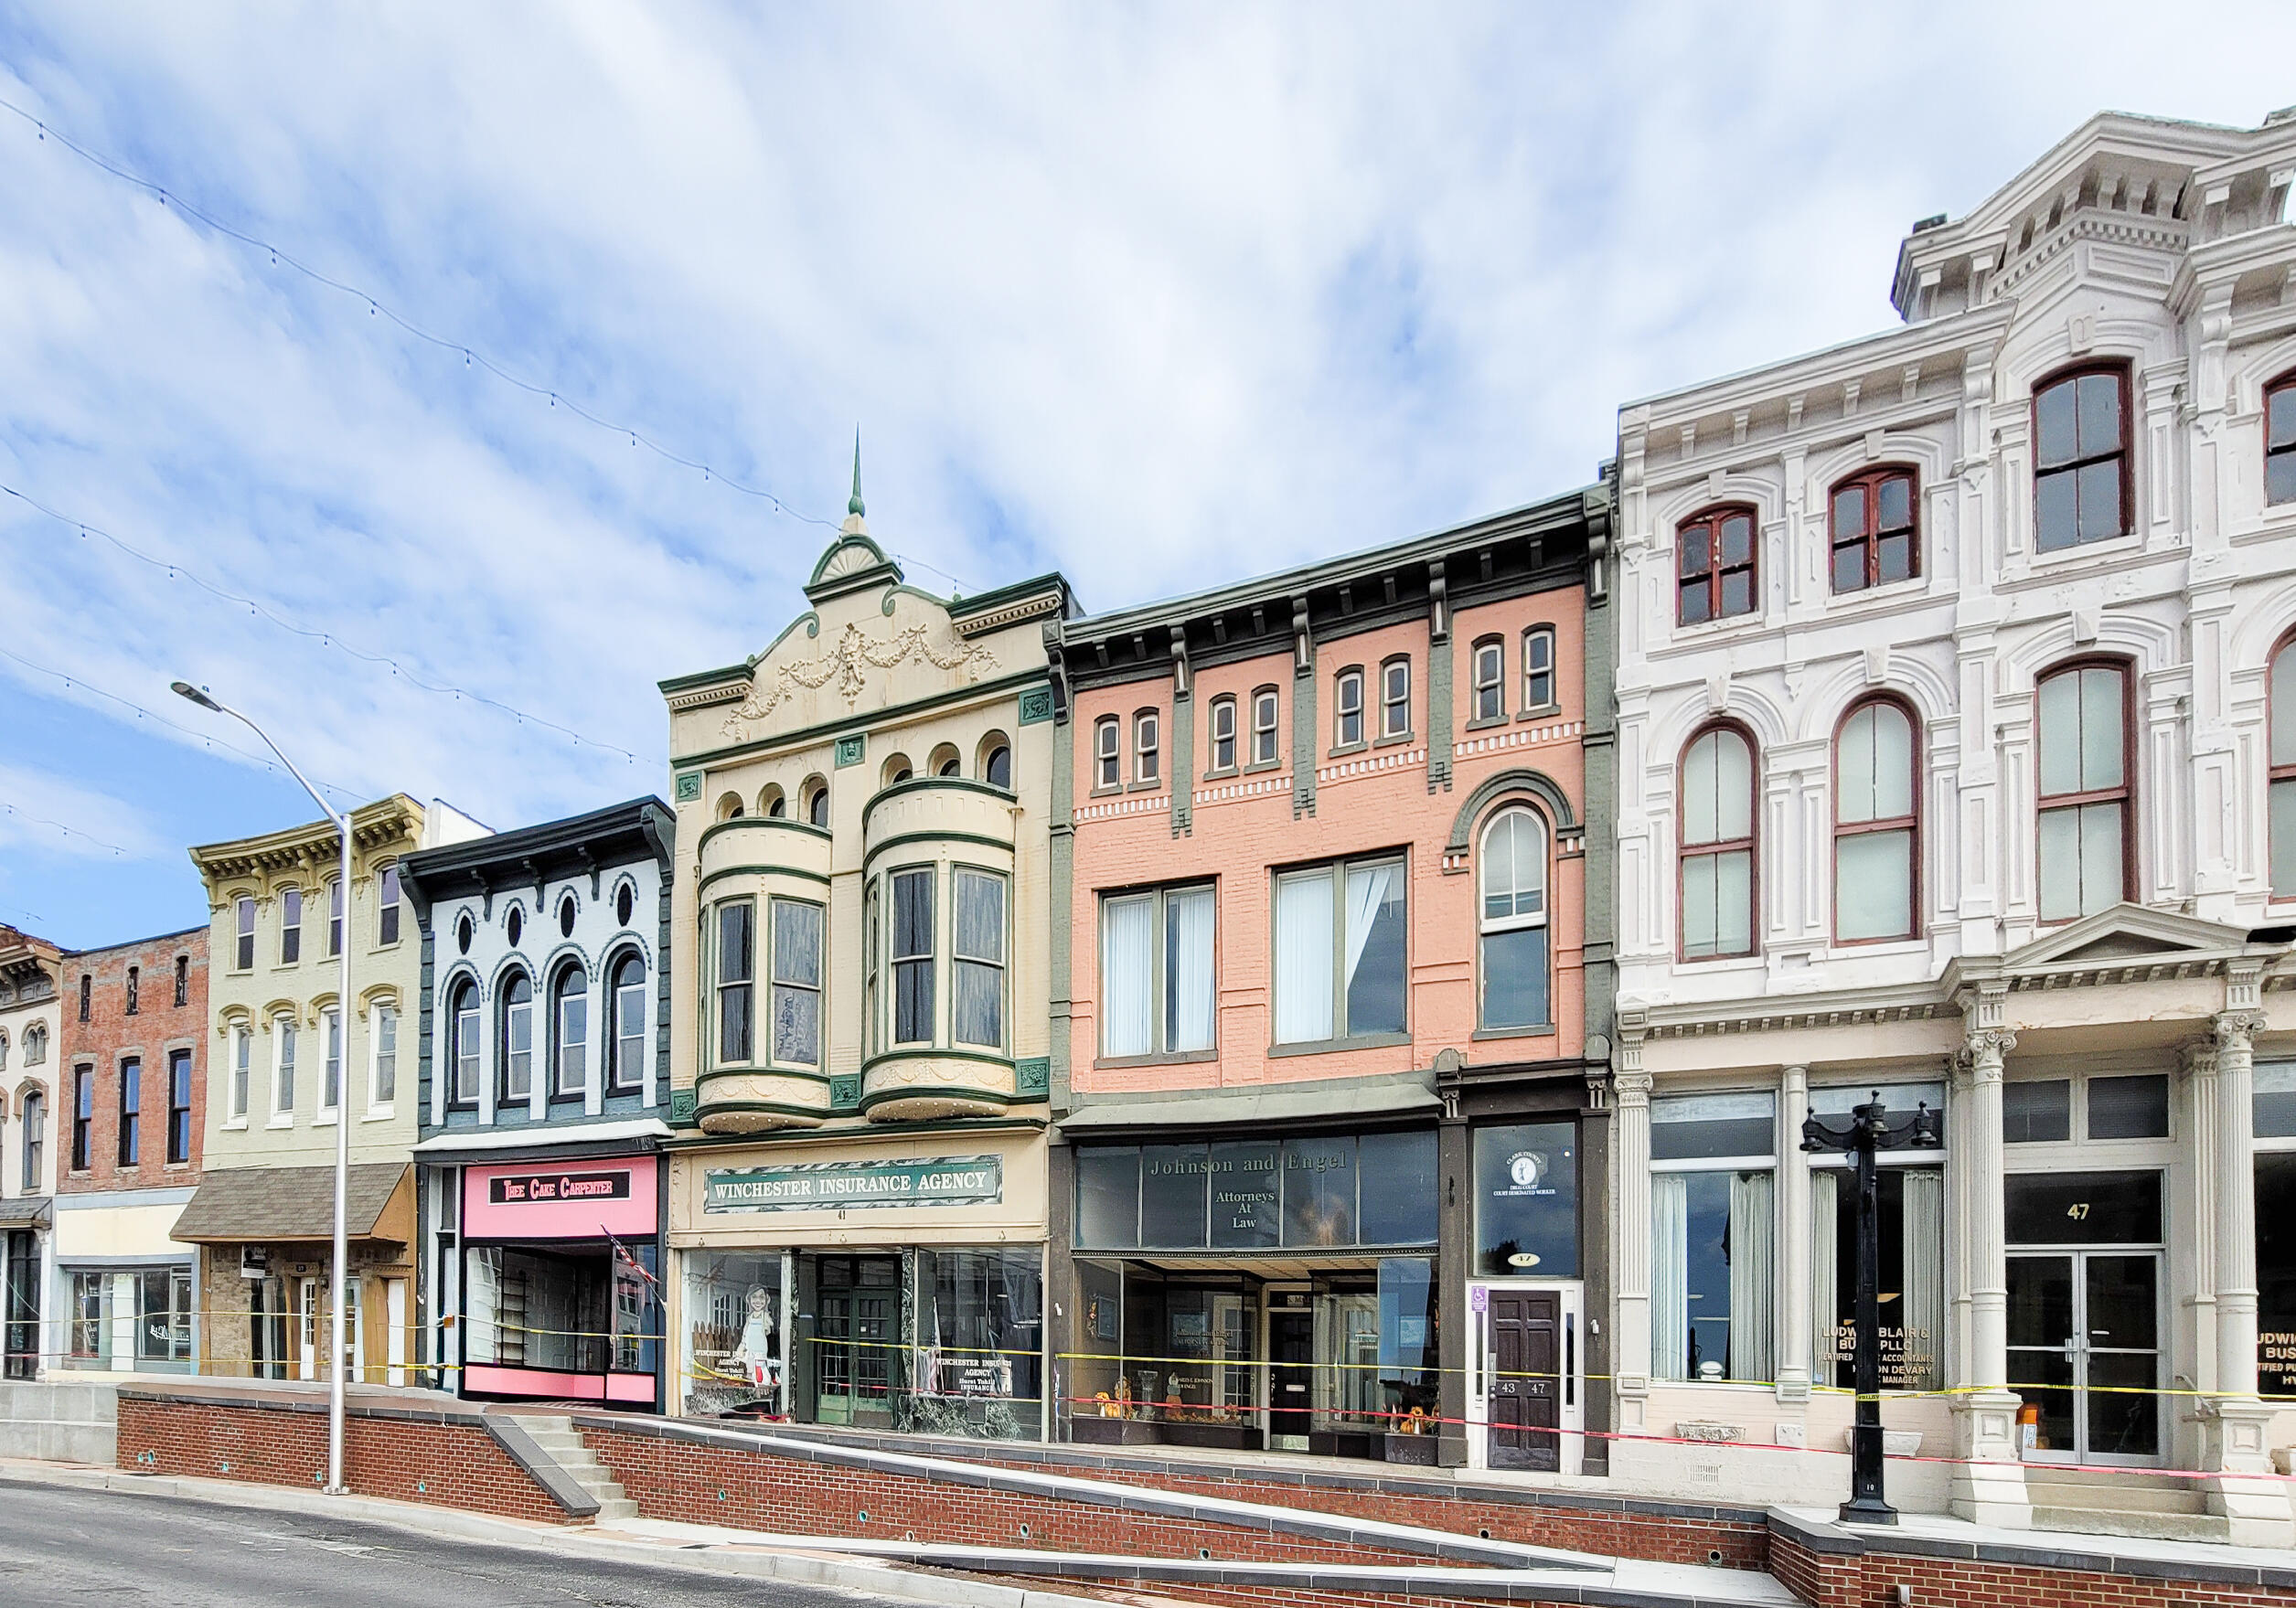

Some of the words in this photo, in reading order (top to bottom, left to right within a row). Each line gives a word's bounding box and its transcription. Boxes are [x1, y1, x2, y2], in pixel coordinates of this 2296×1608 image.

[1151, 1159, 1233, 1176] Johnson
[1244, 1154, 1275, 1171] and
[1287, 1151, 1347, 1173] Engel
[1506, 1152, 1522, 1165] CLARK
[1523, 1152, 1542, 1164] COUNTY
[714, 1179, 812, 1200] WINCHESTER
[819, 1175, 912, 1195] INSURANCE
[917, 1171, 988, 1191] AGENCY
[1215, 1191, 1275, 1203] Attorneys
[838, 1209, 846, 1220] 41
[1238, 1203, 1252, 1214] At
[2067, 1204, 2089, 1219] 47
[1233, 1218, 1256, 1229] Law
[1822, 1326, 1856, 1337] LUDW
[1878, 1327, 1917, 1338] BLAIR
[1880, 1340, 1912, 1351] PLLC
[2266, 1347, 2296, 1359] BUS
[936, 1358, 979, 1367] WINCHESTER
[965, 1368, 991, 1377] AGENCY
[1883, 1376, 1918, 1384] MANAGER
[1501, 1382, 1515, 1393] 43
[1531, 1383, 1545, 1394] 47
